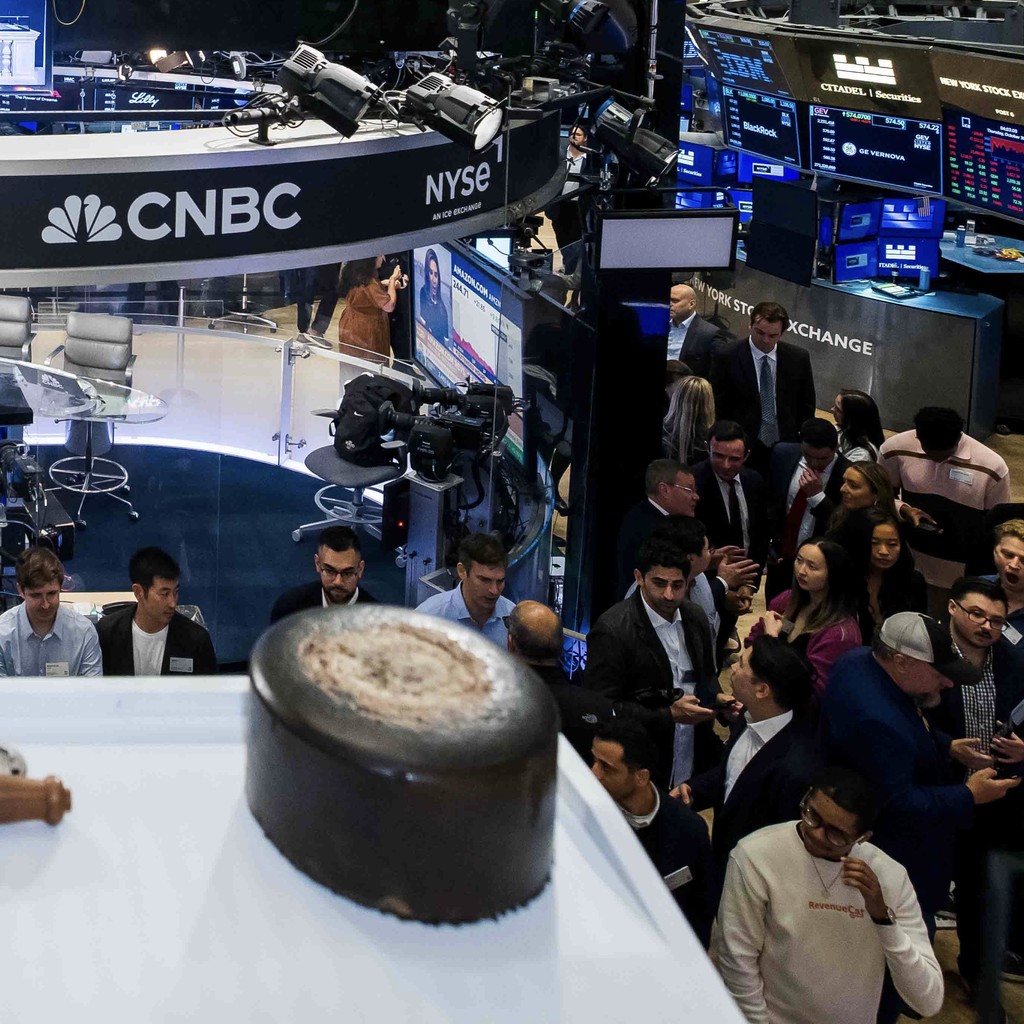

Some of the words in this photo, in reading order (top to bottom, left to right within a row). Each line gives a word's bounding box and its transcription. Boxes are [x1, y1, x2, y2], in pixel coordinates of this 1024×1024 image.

[721, 52, 773, 83] IBM
[820, 83, 867, 96] CITADEL
[875, 90, 922, 104] Securities
[939, 77, 958, 87] NEW
[958, 80, 982, 91] YORK
[982, 84, 1011, 97] STOCK
[129, 91, 159, 107] Lilly
[814, 107, 829, 115] GEV
[870, 150, 906, 161] VERNOVA
[913, 143, 932, 151] NYSE
[127, 182, 302, 241] CNBC
[432, 212, 442, 221] AN
[453, 264, 489, 298] AMAZON.COM
[453, 279, 469, 299] 244.71
[706, 284, 732, 308] YORK
[733, 299, 755, 316] STO
[787, 319, 874, 356] XCHANGE
[808, 901, 865, 918] RevenueCat
